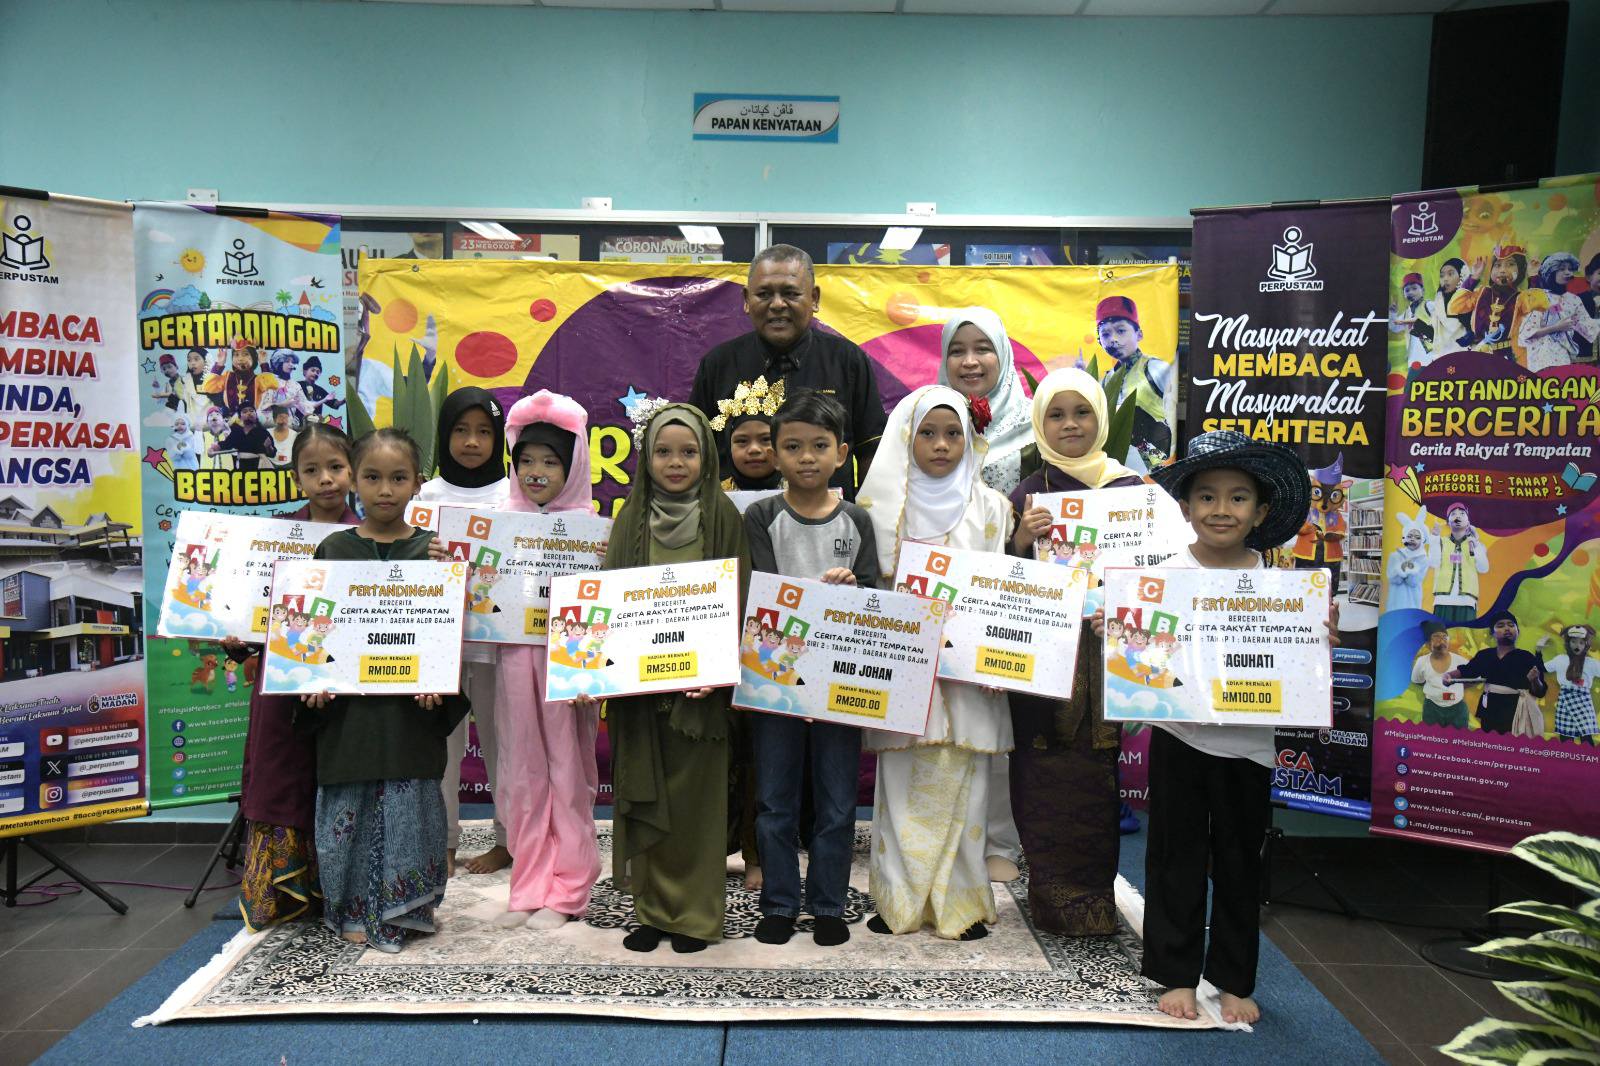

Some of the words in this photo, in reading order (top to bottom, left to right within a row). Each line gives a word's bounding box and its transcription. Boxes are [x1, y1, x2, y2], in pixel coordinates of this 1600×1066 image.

[712, 118, 750, 130] PAPAN
[753, 119, 821, 131] KENYATAAN
[616, 241, 705, 253] CORONAVIRUS
[1402, 234, 1444, 244] PERPUSTAM
[216, 278, 265, 287] PERPUSTAM
[1260, 281, 1323, 292] PERPUSTAM
[142, 310, 339, 351] PERTANDINGAN
[1195, 310, 1389, 360] Masyarakat
[1214, 353, 1363, 377] MEMBACA
[1410, 376, 1596, 402] PERTANDINGAN
[1192, 378, 1388, 427] Masyarakat
[1402, 404, 1600, 438] BERCERITA
[1410, 443, 1452, 456] Cerita
[1454, 443, 1509, 460] Rakyat
[1514, 443, 1592, 460] Tempatan
[0, 458, 91, 484] NGSA
[176, 470, 307, 504] BERCERIT
[1425, 474, 1480, 484] KATEGORI
[1485, 475, 1492, 484] A
[1508, 476, 1548, 486] TAHAP
[1424, 484, 1480, 494] KATEGORI
[1485, 485, 1492, 494] B
[1508, 487, 1550, 497] TAHAP
[1555, 486, 1563, 496] 2
[1066, 502, 1080, 516] C
[473, 520, 487, 536] C
[1104, 532, 1132, 540] CERITA
[514, 536, 600, 553] PERTANDINGA
[536, 560, 566, 568] RAKYAT
[932, 556, 946, 572] C
[348, 584, 444, 598] PERTANDINGAN
[583, 582, 596, 597] C
[624, 581, 716, 602] PERTANDINGAN
[971, 575, 1064, 600] PERTANDINGAN
[1143, 582, 1158, 598] C
[654, 600, 686, 608] BERCERITA
[784, 588, 798, 604] C
[1000, 594, 1032, 605] BERCERITA
[617, 611, 644, 620] CERITA
[646, 608, 678, 616] RAKYAT
[680, 603, 724, 613] TEMPATAN
[962, 596, 990, 606] CERITA
[991, 602, 1022, 612] RAKYAT
[1024, 606, 1068, 619] TEMPATAN
[824, 608, 921, 634] PERTANDINGAN
[979, 608, 998, 617] TAHAP
[1008, 613, 1032, 623] DAERAH
[1034, 617, 1050, 626] ALOR
[1052, 620, 1072, 629] GAJAH
[652, 630, 685, 645] JOHAN
[854, 628, 887, 640] BERCERITA
[986, 624, 1032, 644] SAGUHATI
[1260, 626, 1312, 634] TEMPATAN
[368, 632, 416, 646] SAGUHATI
[814, 631, 842, 642] CERITA
[845, 637, 877, 646] RAKYAT
[880, 641, 924, 654] TEMPATAN
[1242, 636, 1271, 644] DAERAH
[832, 644, 852, 652] TAHAP
[862, 648, 887, 658] DAERAH
[890, 652, 906, 661] ALOR
[908, 654, 928, 664] GAJAH
[1223, 654, 1274, 668] AGUHATI
[368, 666, 410, 676] RM100.00
[646, 662, 690, 674] RM250.00
[833, 661, 856, 676] NAIB
[858, 665, 892, 682] JOHAN
[984, 657, 1026, 673] RM100.00
[101, 700, 137, 709] MADANI
[836, 695, 880, 710] RM200.00
[1222, 692, 1272, 704] RM100.00
[1331, 736, 1367, 746] MADANI
[1384, 730, 1448, 744] #MalaysiaMembaca
[1452, 738, 1514, 752] #MelakaMembaca
[1519, 748, 1598, 763] #Baca@PERPUSTAM
[188, 750, 228, 760] perpustam
[1412, 750, 1540, 774] www.facebook.com/perpustam
[1411, 768, 1509, 788] www.perpustam.gov.my
[1410, 784, 1454, 796] perpustam
[1280, 790, 1348, 808] #MelakaMembaca
[1410, 802, 1532, 828] www.twitter.com/_perpustam
[1409, 820, 1474, 836] t.me/perpustam
